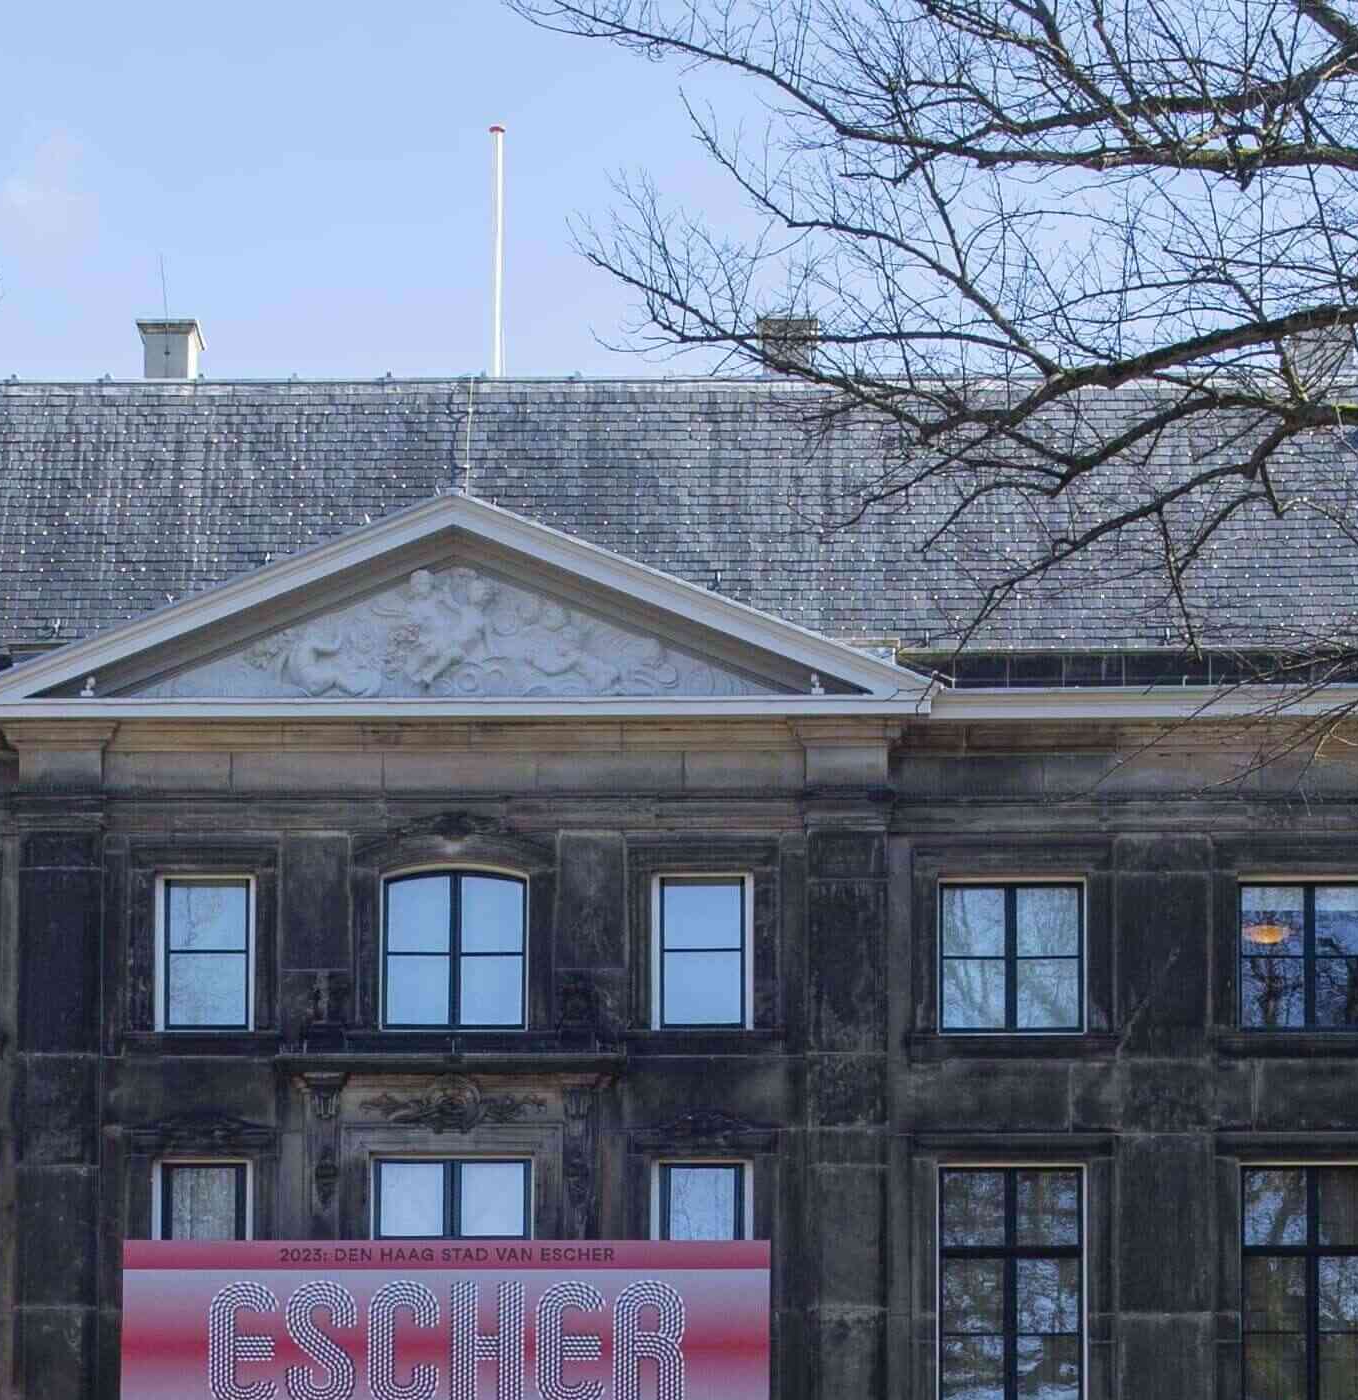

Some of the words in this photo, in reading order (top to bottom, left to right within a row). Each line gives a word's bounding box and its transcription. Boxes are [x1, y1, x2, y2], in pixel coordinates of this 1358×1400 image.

[279, 1247, 327, 1263] 2023:
[334, 1247, 372, 1263] DEN
[380, 1247, 434, 1263] HAAG
[442, 1247, 489, 1263] STAD
[495, 1247, 533, 1263] VAN
[540, 1247, 615, 1263] ESCHER
